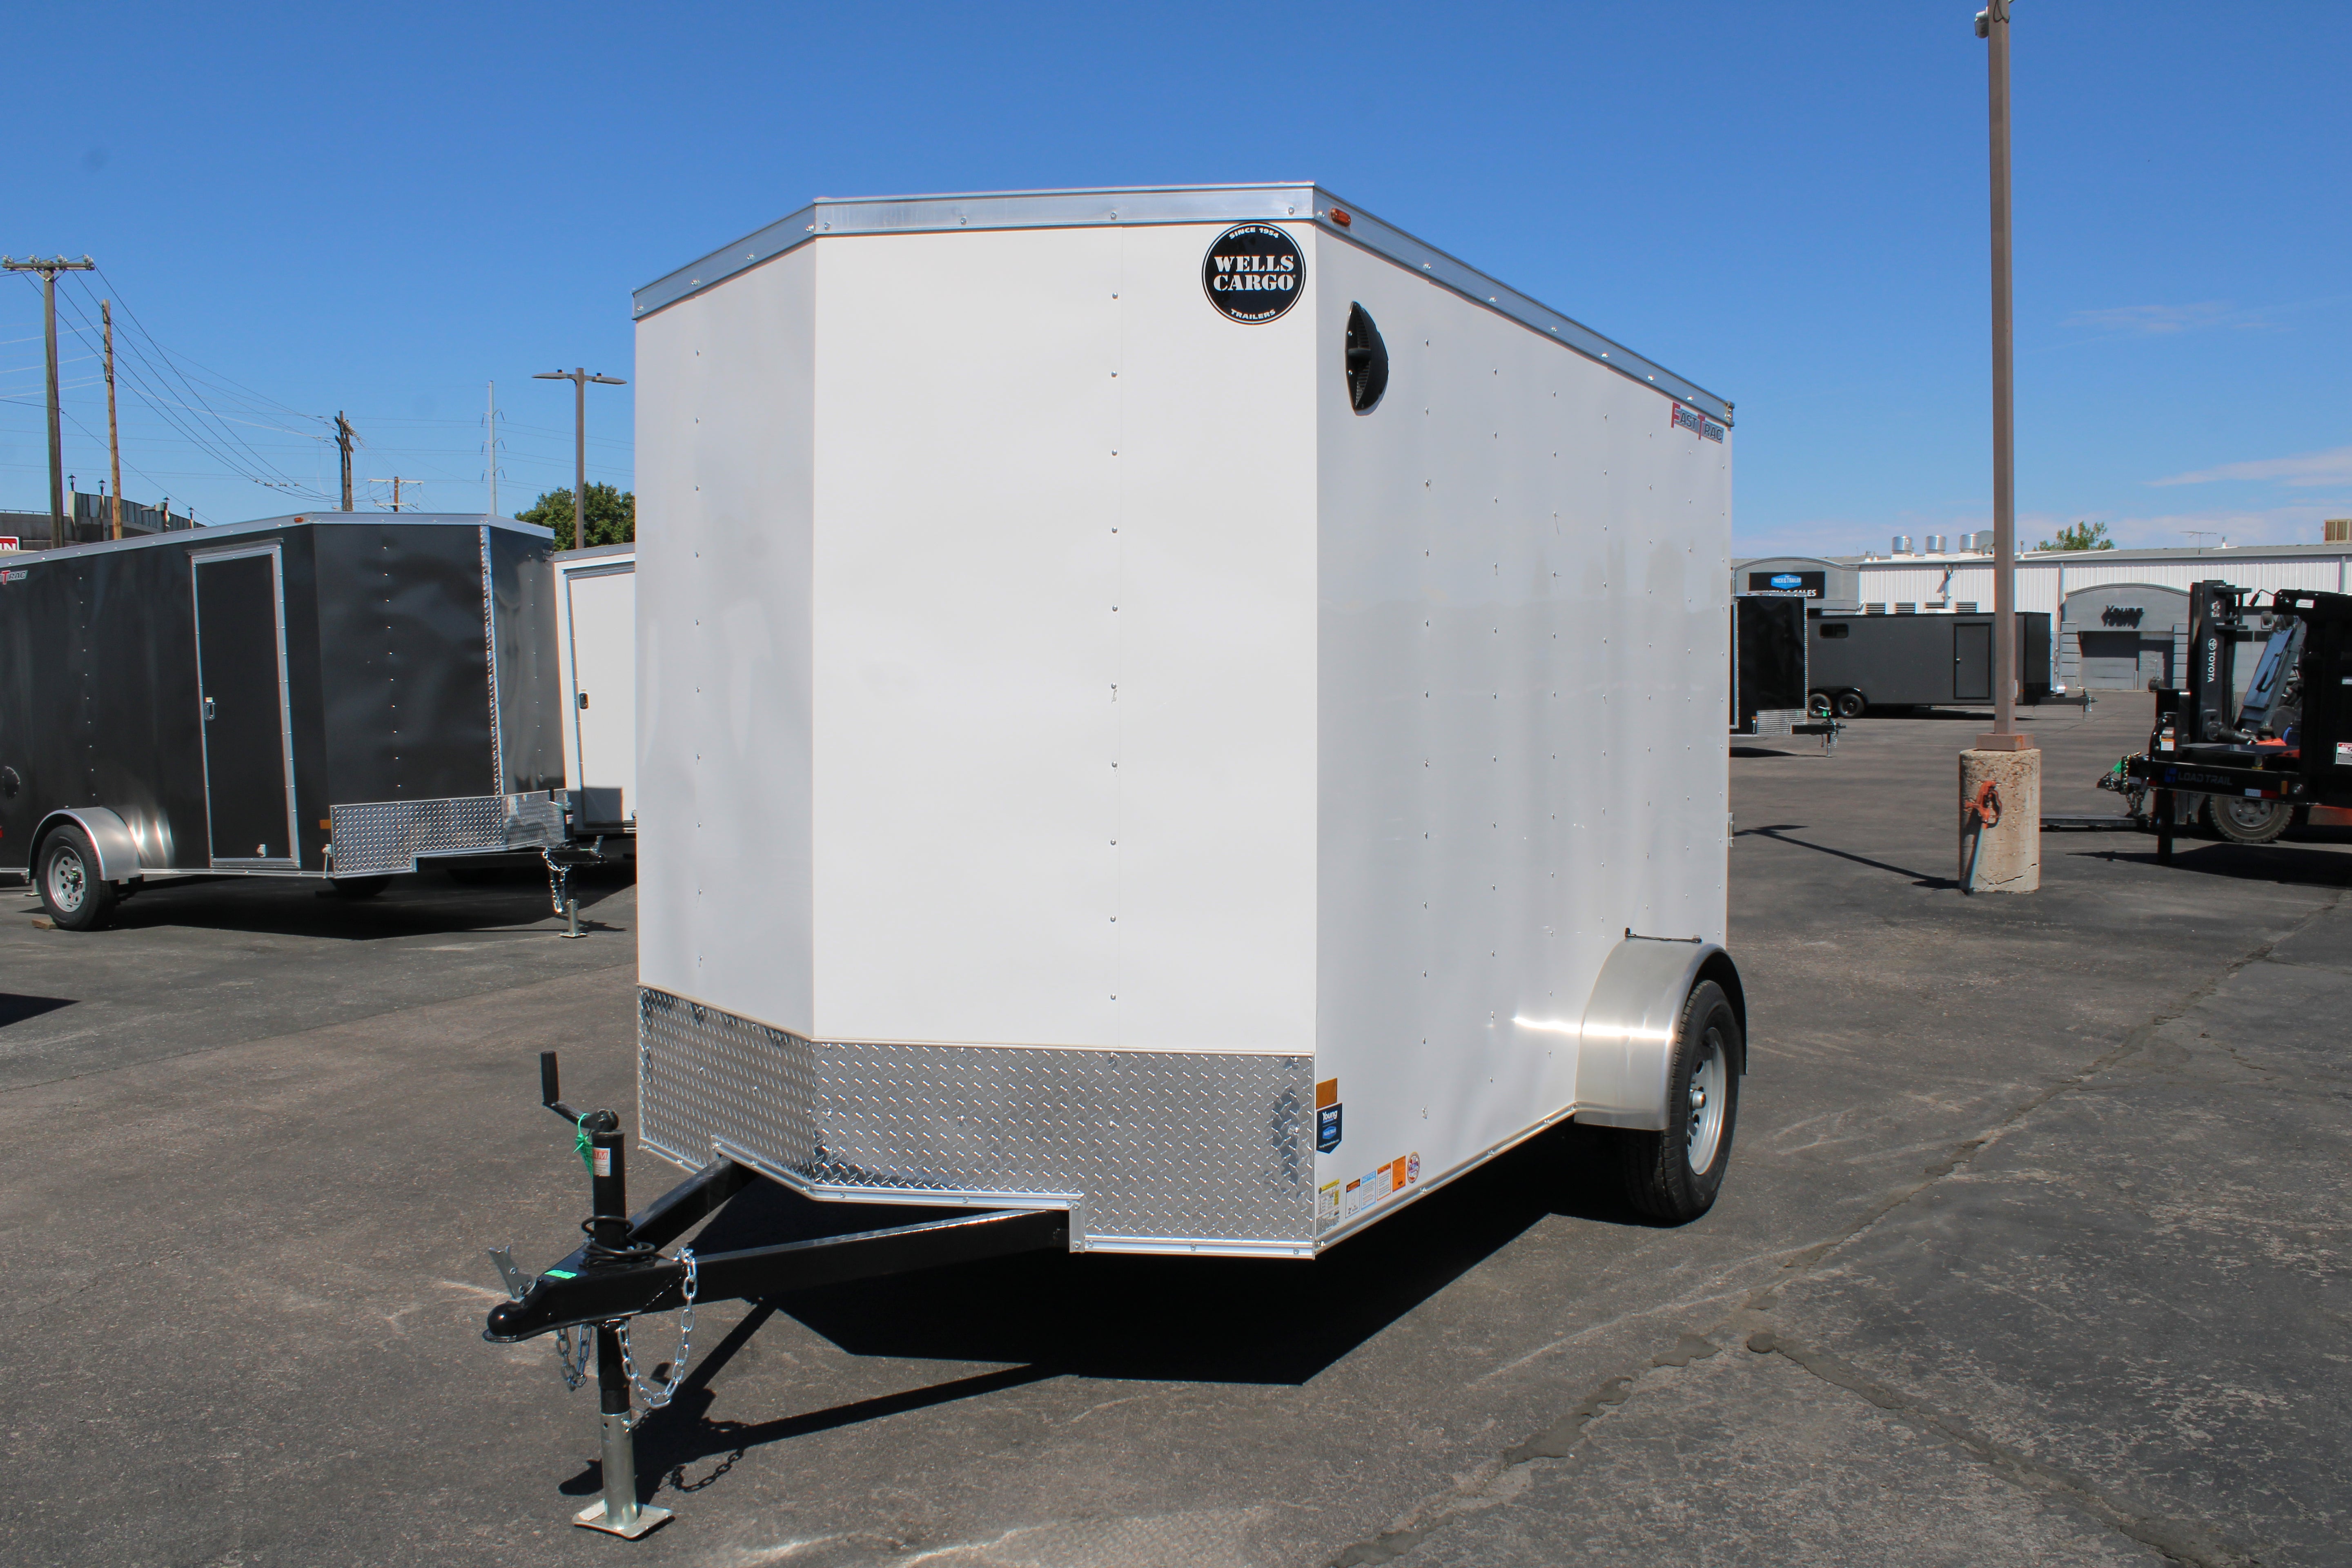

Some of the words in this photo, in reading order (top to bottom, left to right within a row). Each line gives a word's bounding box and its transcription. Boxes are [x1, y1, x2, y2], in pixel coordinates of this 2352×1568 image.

[1229, 227, 1256, 240] SINCE
[1259, 227, 1279, 238] 1954
[1214, 255, 1294, 273] WELLS
[1213, 274, 1294, 291] CARGO
[1231, 308, 1276, 320] TRAILERS
[2207, 651, 2216, 683] TOYOTA
[2178, 771, 2204, 783] LOAD
[2205, 774, 2233, 786] TRAIL
[1322, 1110, 1338, 1121] Young
[594, 1152, 608, 1160] AM
[1362, 1172, 1375, 1182] NOTICE
